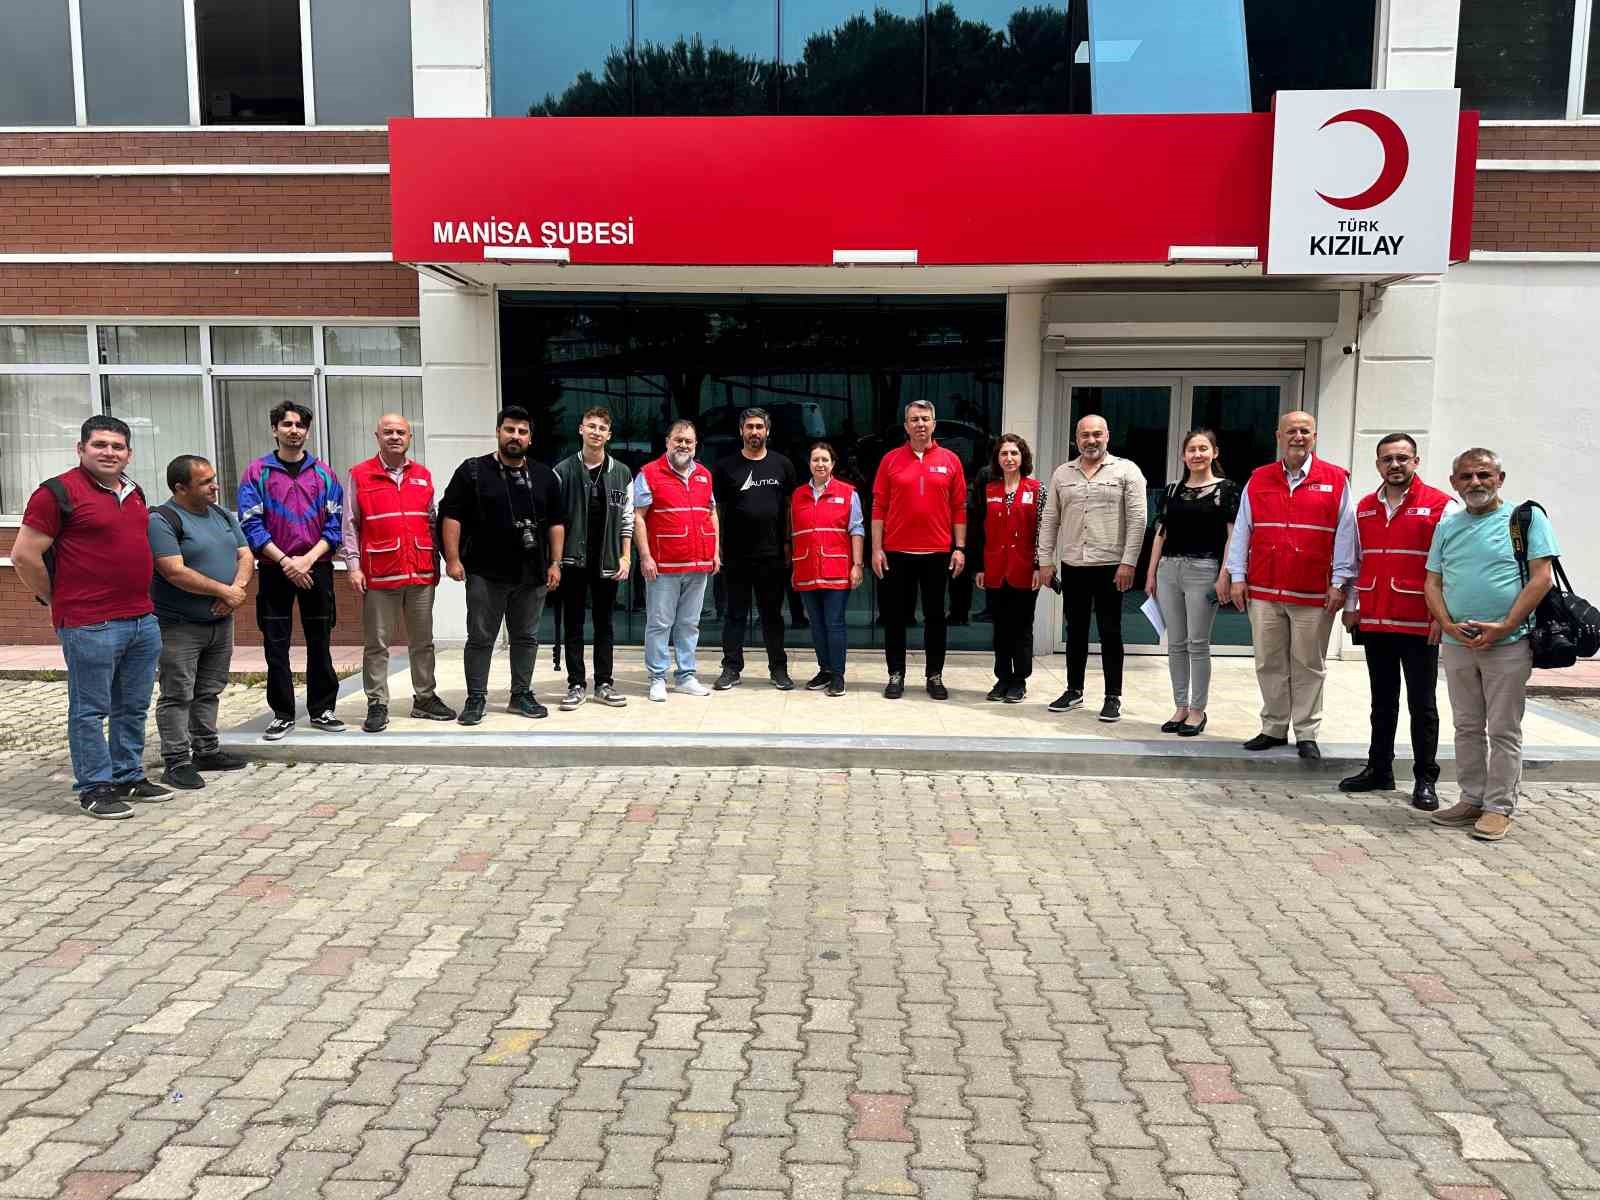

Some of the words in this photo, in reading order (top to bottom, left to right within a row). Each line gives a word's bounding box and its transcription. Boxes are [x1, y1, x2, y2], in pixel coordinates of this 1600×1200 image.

[433, 216, 532, 244] MANİSA
[540, 216, 634, 248] ŞUBESİ
[1338, 217, 1379, 232] TÜRK
[1310, 235, 1405, 255] KIZILAY
